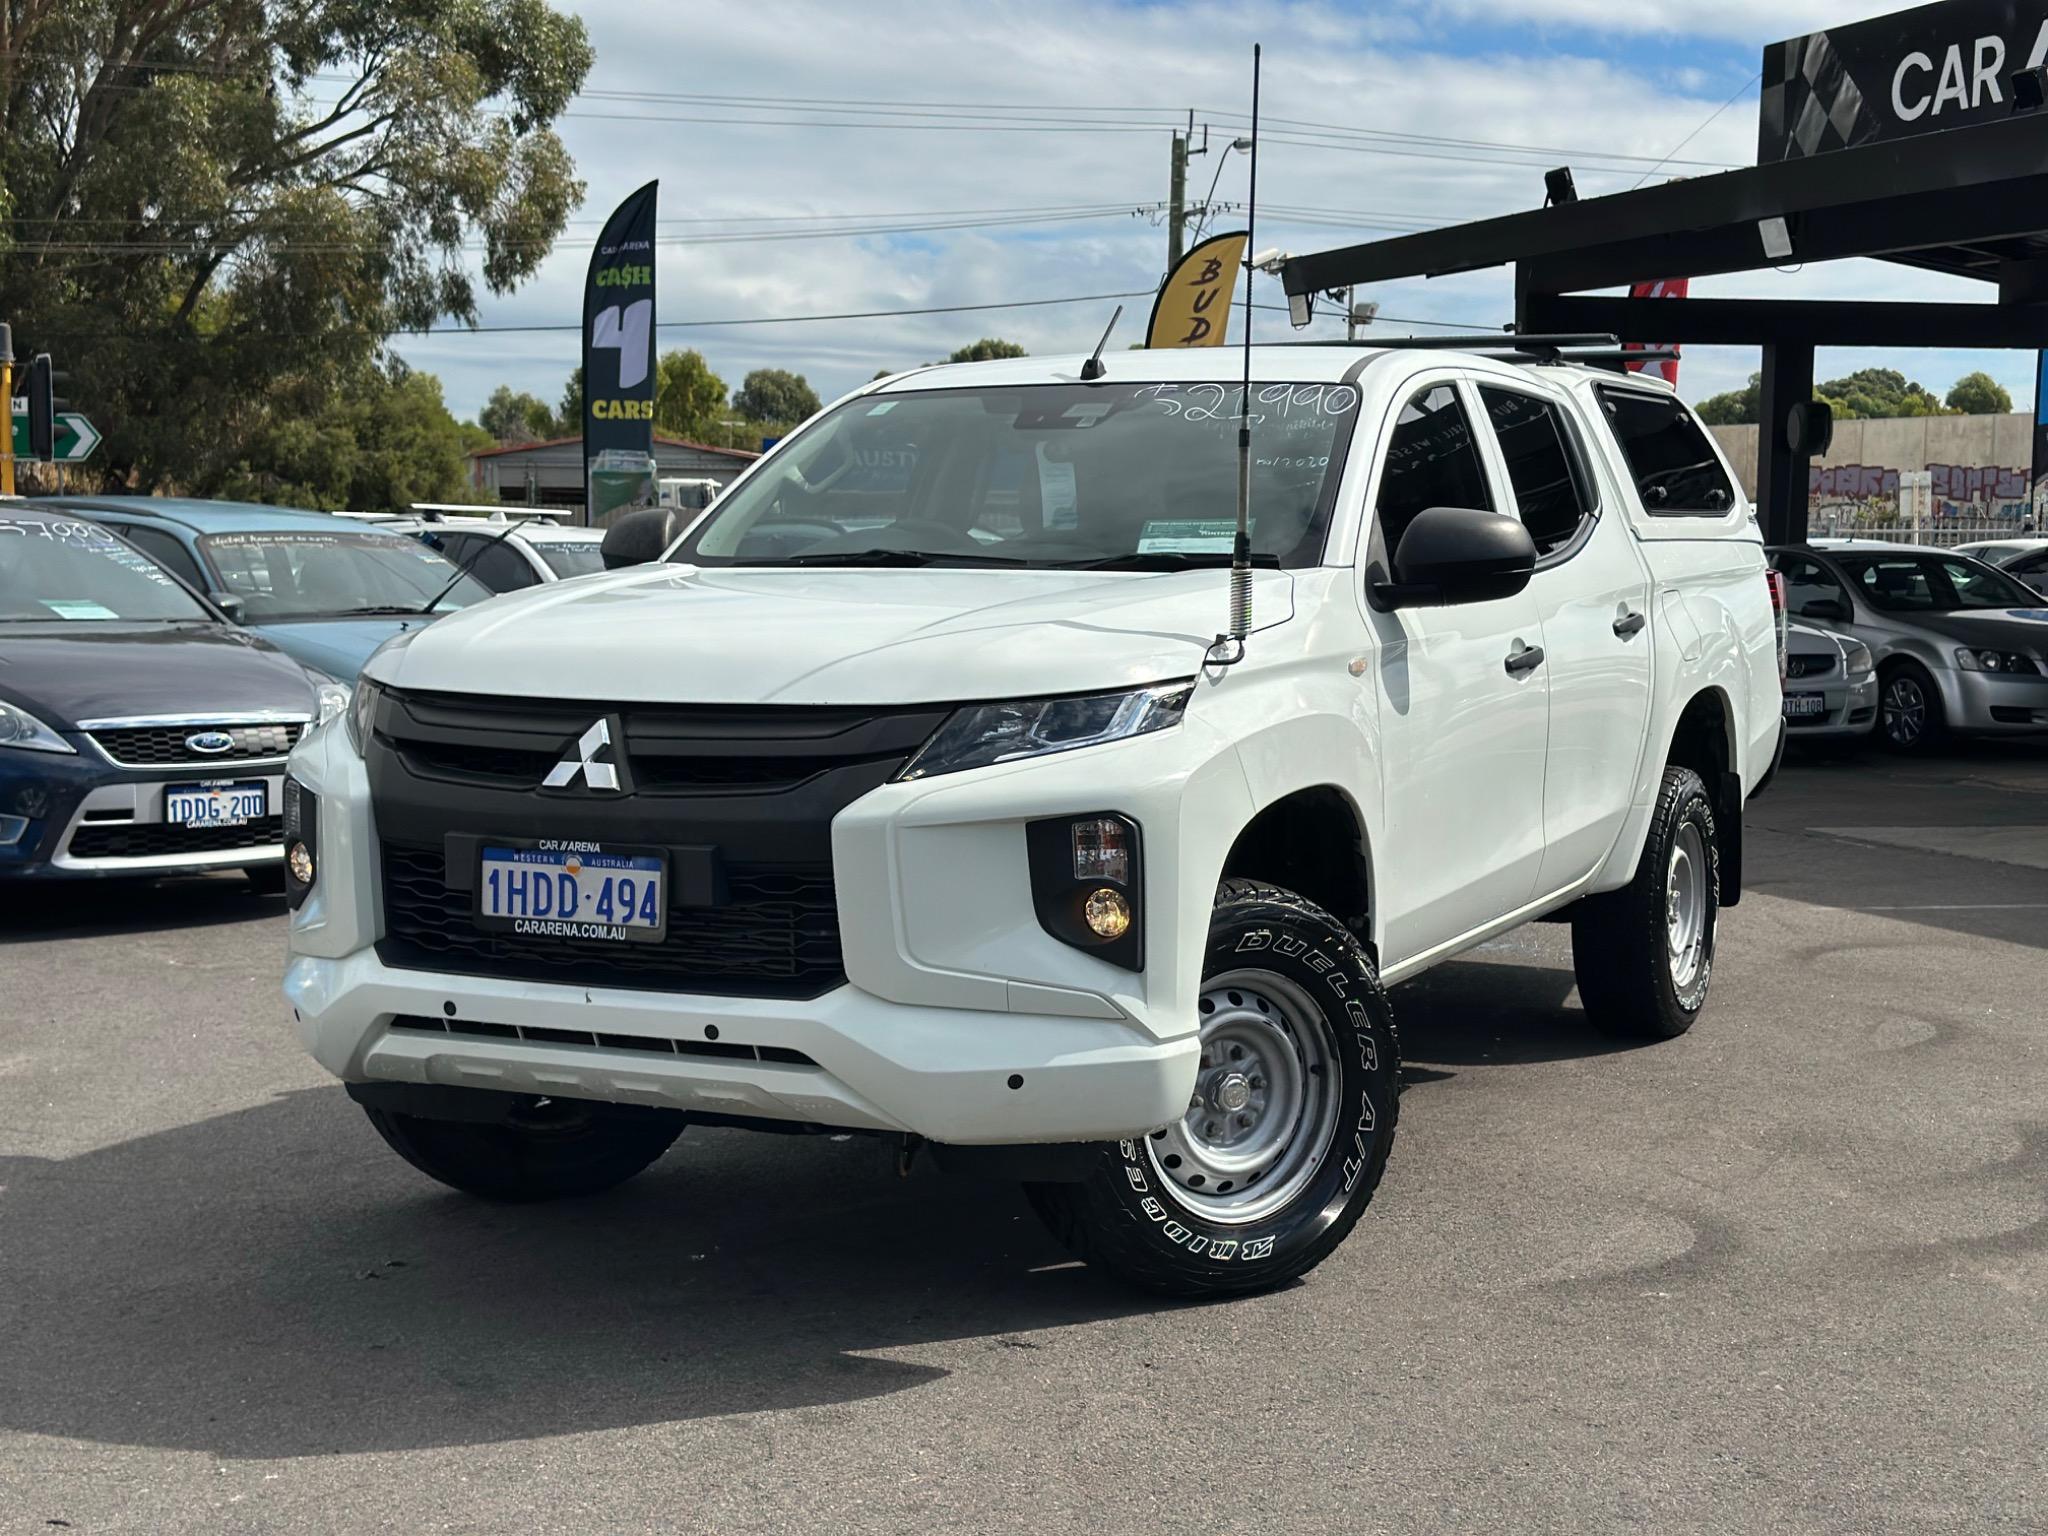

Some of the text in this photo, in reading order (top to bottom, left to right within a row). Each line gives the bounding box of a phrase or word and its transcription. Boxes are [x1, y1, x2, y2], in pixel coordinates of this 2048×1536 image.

[1891, 35, 2006, 122] CAR
[597, 262, 652, 289] CA$H
[592, 299, 652, 389] 4
[592, 399, 654, 420] CARS
[539, 839, 559, 851] CAR
[513, 853, 634, 869] WESTERN AUSTRALIA
[514, 919, 626, 941] CARARENA.COM.AU
[1235, 929, 1378, 1192] DUELER A/T
